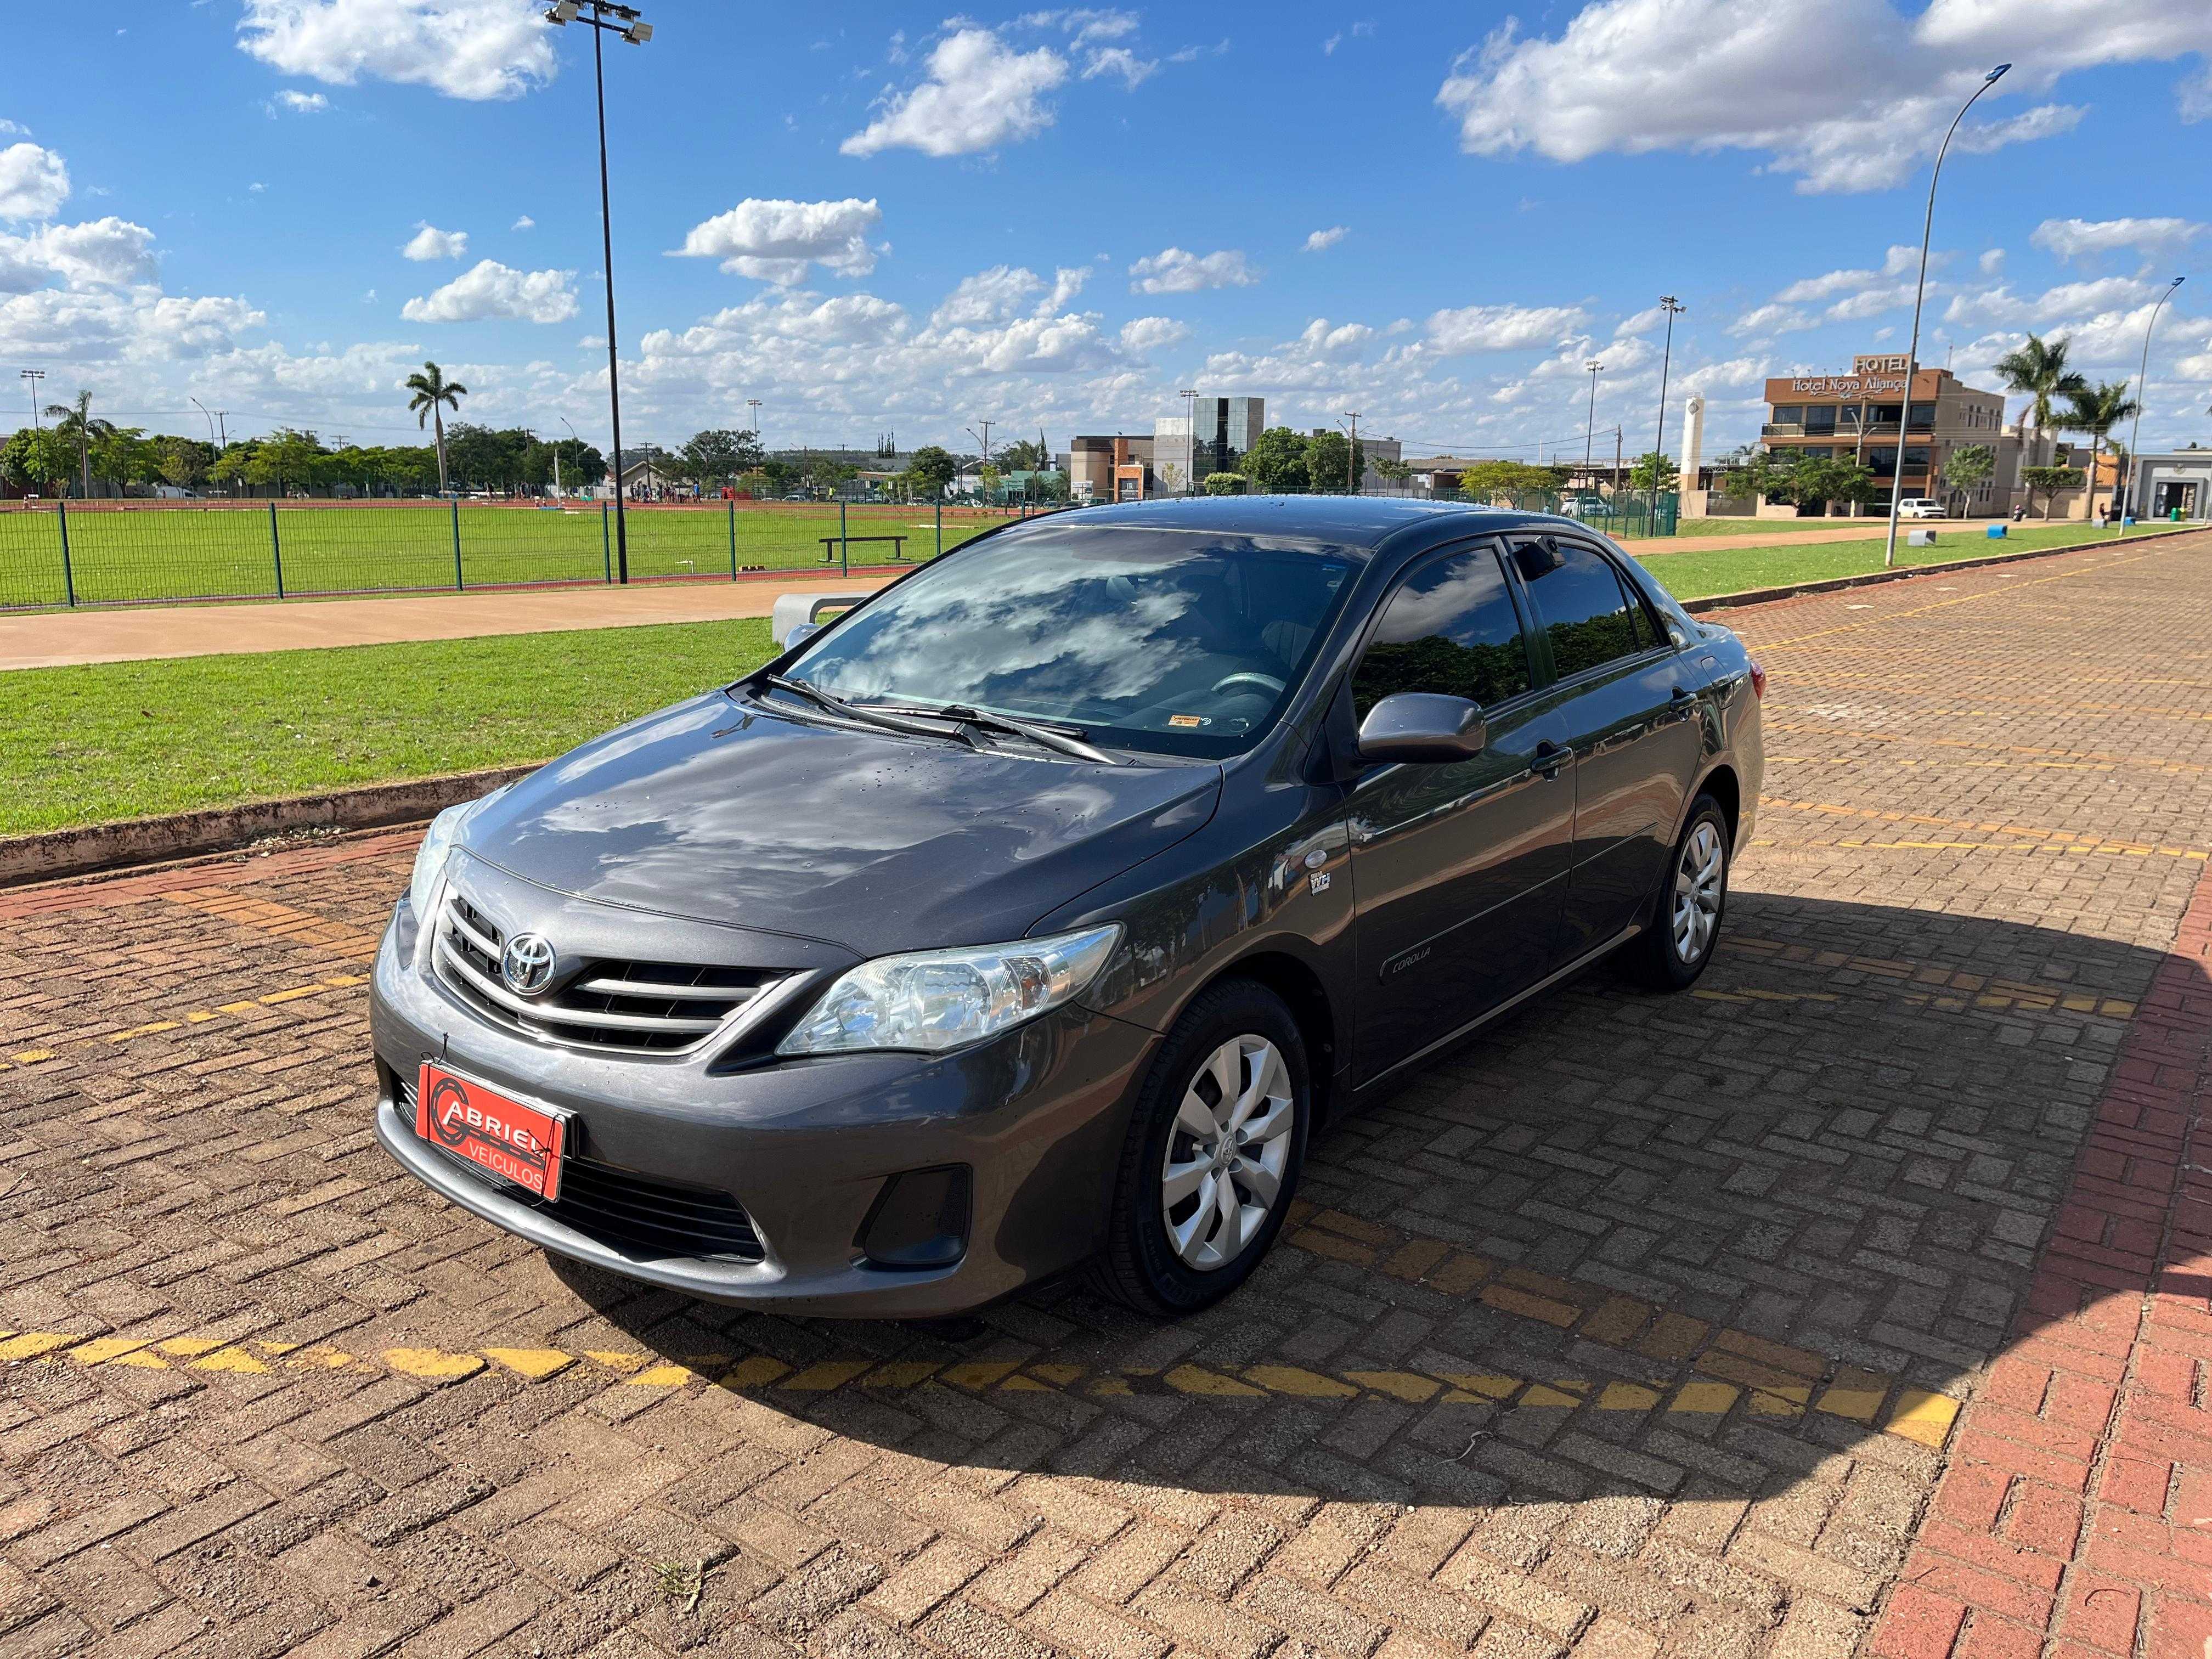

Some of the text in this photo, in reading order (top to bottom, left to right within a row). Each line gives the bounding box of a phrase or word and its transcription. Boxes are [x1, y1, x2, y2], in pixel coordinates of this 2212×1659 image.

[1855, 357, 1907, 372] HOTEL
[1793, 377, 1908, 392] Hotel Nova Aliança
[1392, 946, 1431, 973] COROLLA
[469, 1142, 543, 1189] VEÍCULOS
